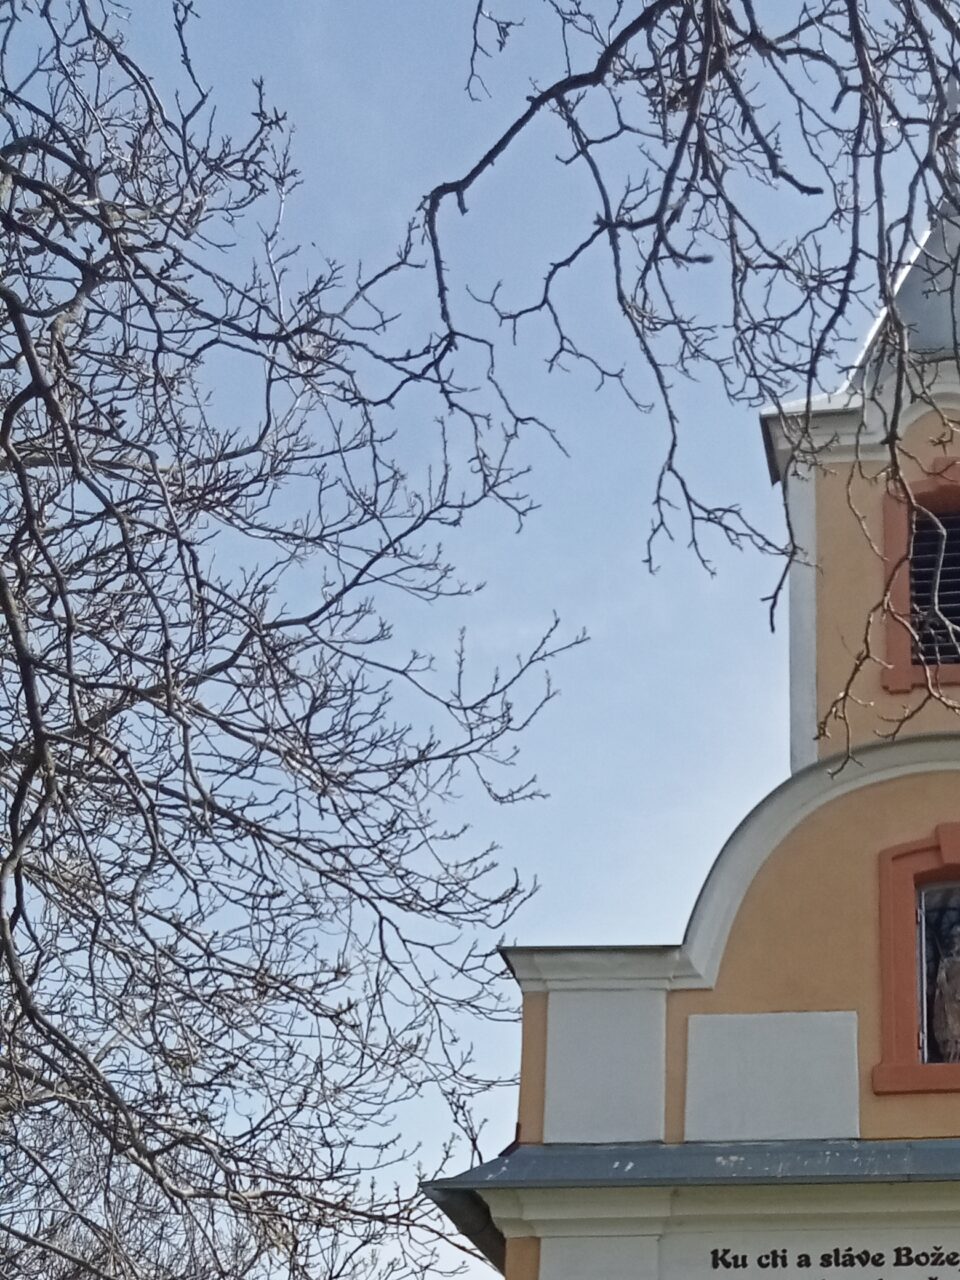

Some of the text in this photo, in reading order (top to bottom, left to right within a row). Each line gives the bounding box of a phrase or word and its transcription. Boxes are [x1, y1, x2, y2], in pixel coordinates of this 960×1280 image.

[710, 1248, 748, 1270] Ku
[757, 1247, 788, 1269] cti
[796, 1251, 812, 1268] a
[819, 1246, 886, 1268] sláve
